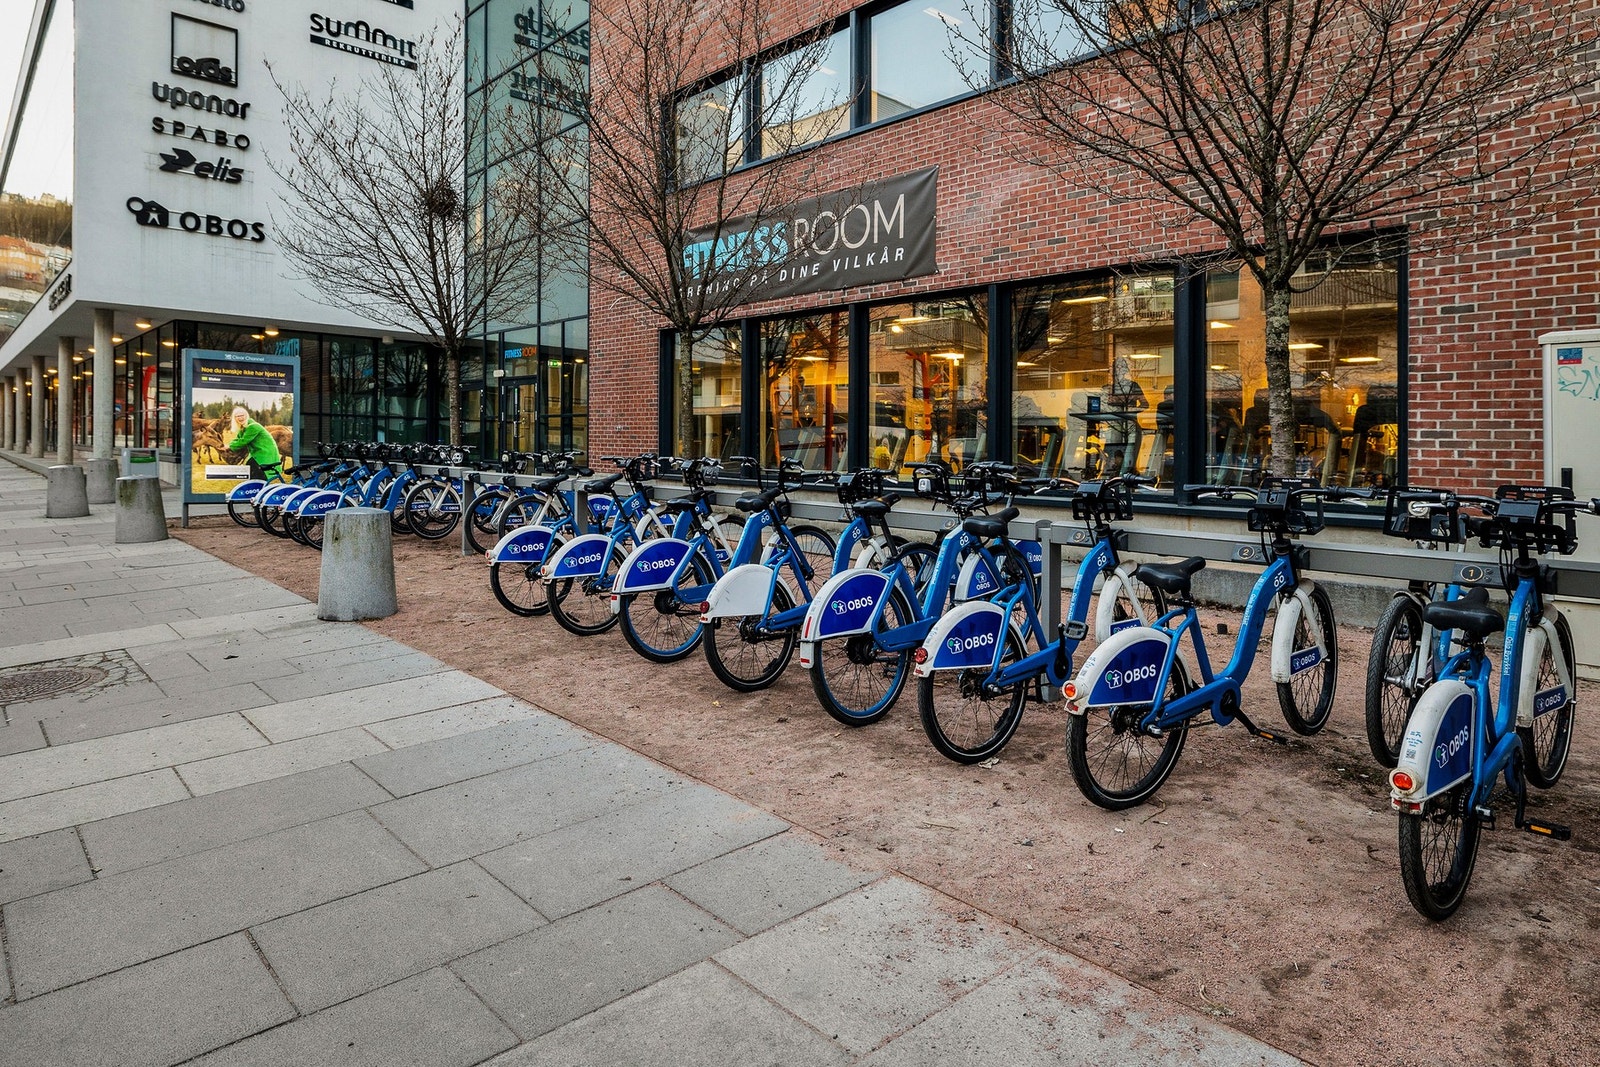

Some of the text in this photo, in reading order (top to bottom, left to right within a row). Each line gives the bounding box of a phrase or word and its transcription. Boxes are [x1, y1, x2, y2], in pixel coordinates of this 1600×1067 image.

[310, 13, 417, 60] summit
[324, 39, 406, 66] REKRUTTERING
[152, 81, 251, 120] uponor
[152, 117, 250, 150] SPABO
[194, 157, 244, 184] elis
[179, 211, 265, 242] OBOS
[779, 263, 820, 282] DINE
[833, 245, 905, 272] VILKÅR
[521, 542, 545, 552] OBOS
[577, 552, 602, 565] OBOS
[651, 558, 676, 570] OBOS
[976, 580, 991, 591] OBOS
[847, 595, 874, 611] OBOS
[964, 632, 994, 650] OBOS
[1300, 653, 1316, 666] OBOS
[1124, 663, 1157, 683] OBOS
[1544, 692, 1562, 707] OBOS
[1448, 725, 1469, 757] OBOS
